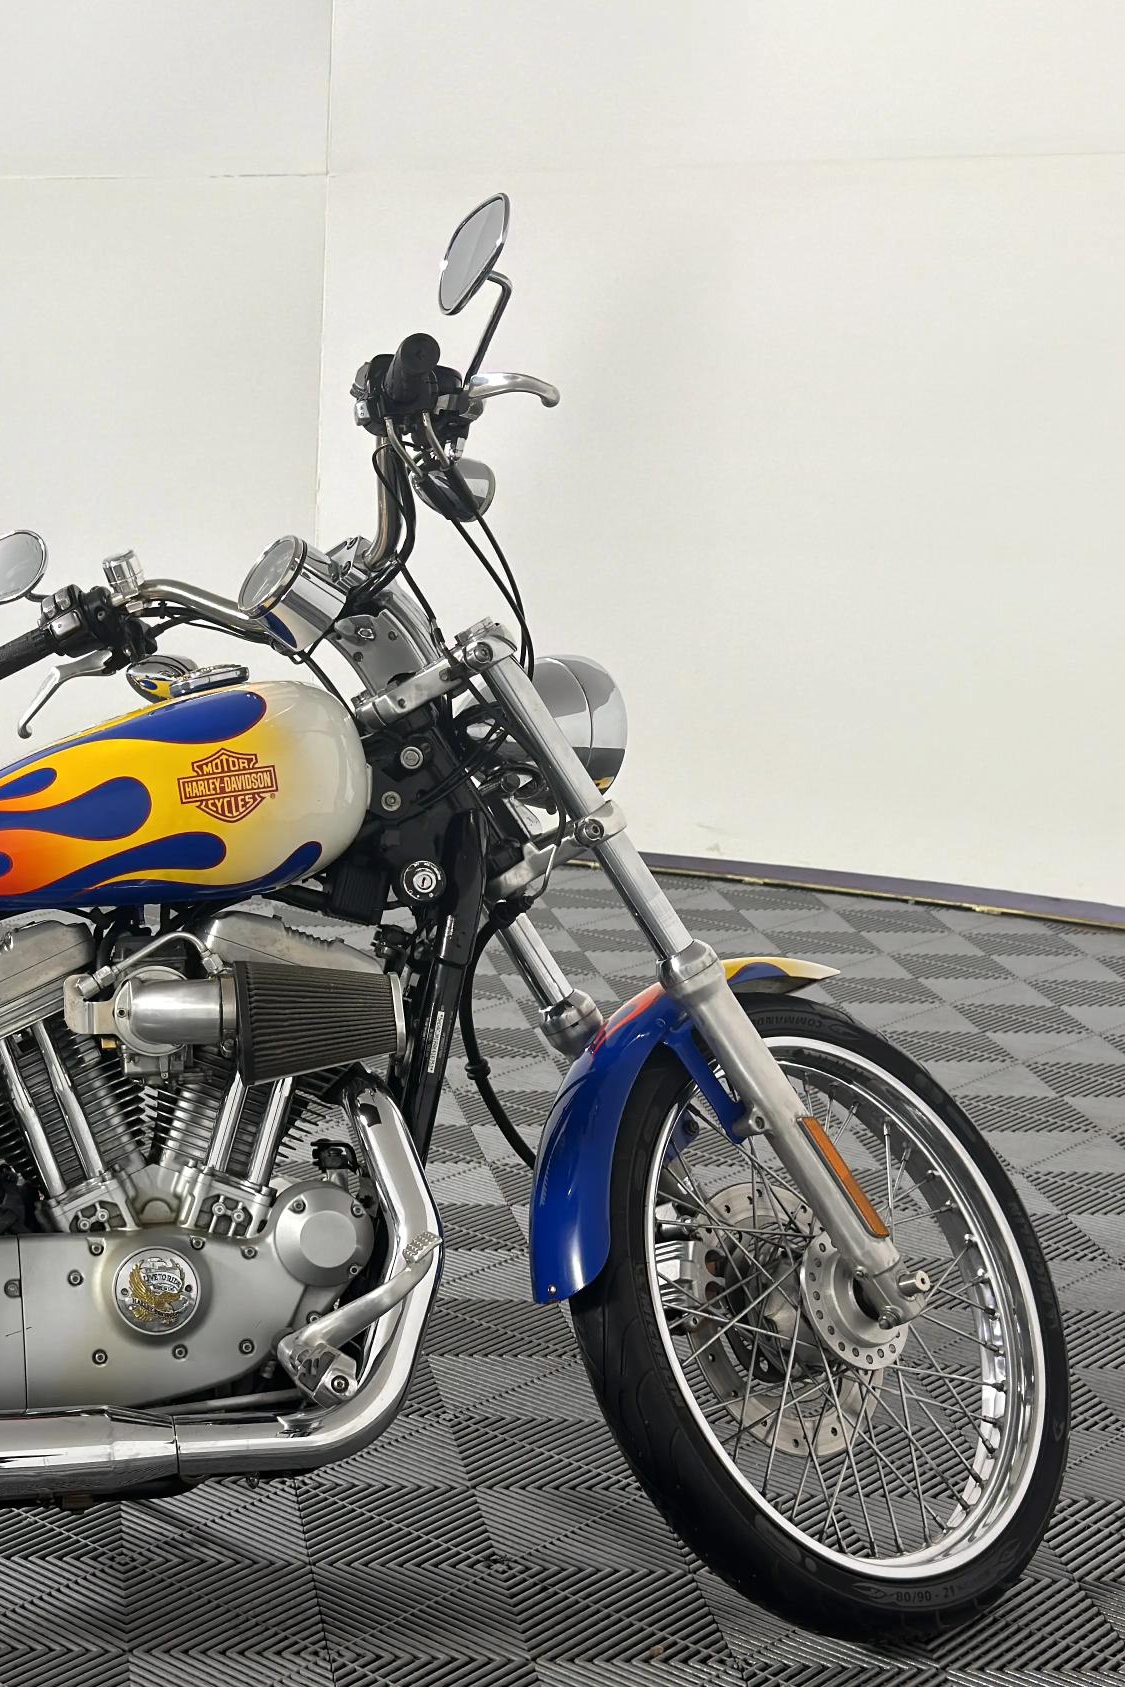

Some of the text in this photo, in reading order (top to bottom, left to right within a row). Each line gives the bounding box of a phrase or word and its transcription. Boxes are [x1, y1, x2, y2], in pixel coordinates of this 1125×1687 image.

[203, 755, 248, 774] MOTOR
[184, 771, 272, 798] HARLEY-DAVIDSON
[207, 794, 253, 817] CYCLES
[896, 1590, 932, 1603] 80/90
